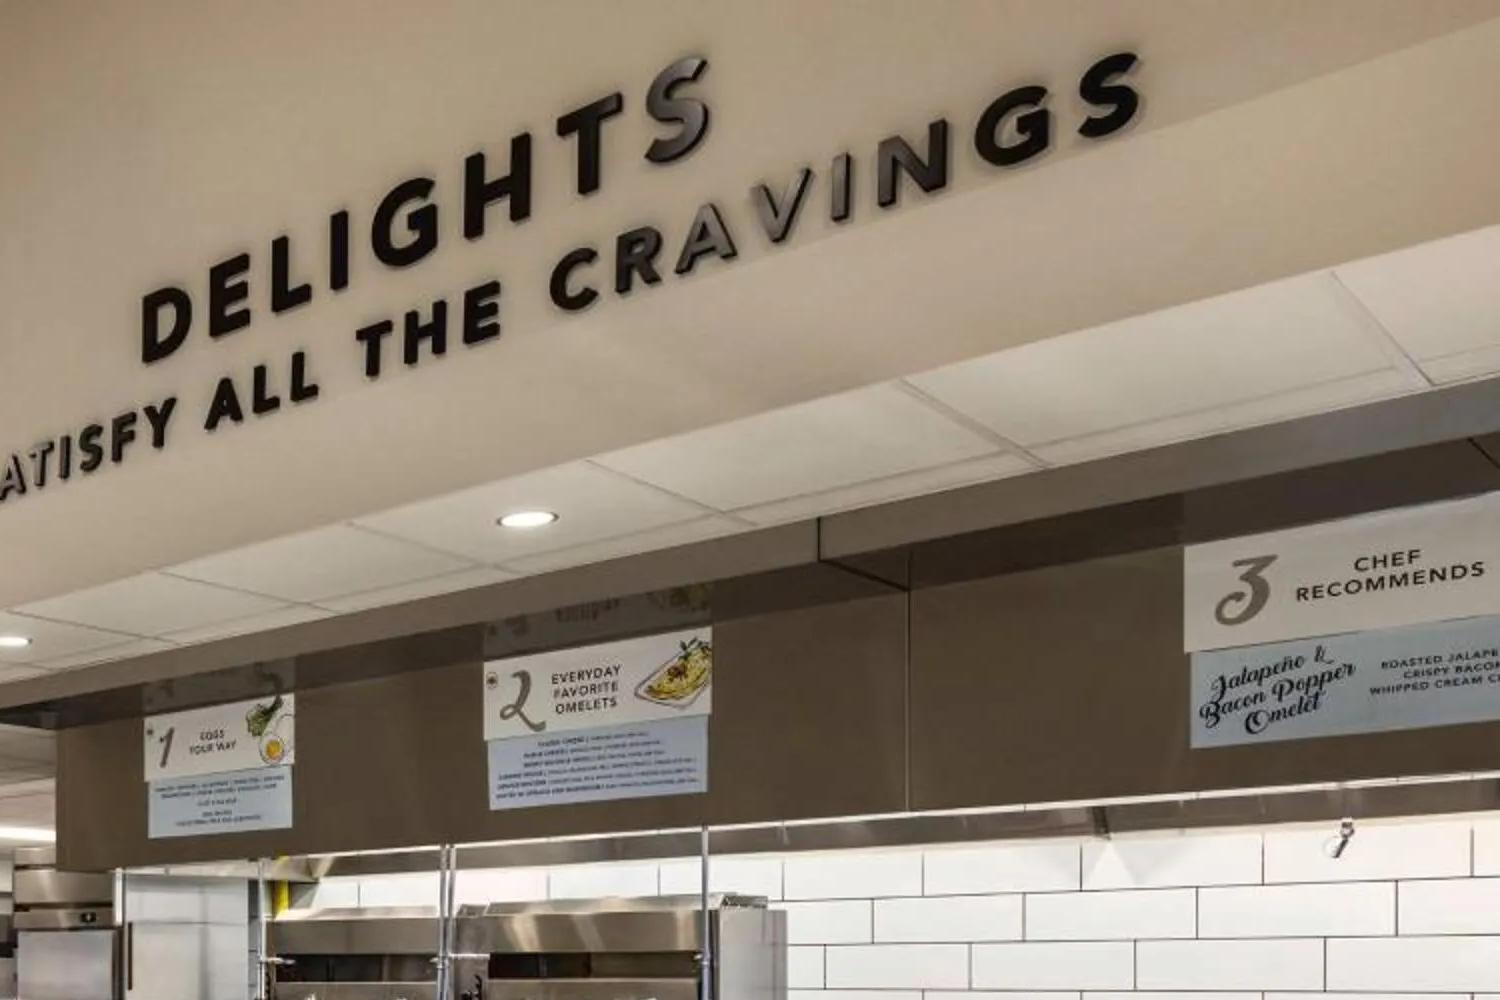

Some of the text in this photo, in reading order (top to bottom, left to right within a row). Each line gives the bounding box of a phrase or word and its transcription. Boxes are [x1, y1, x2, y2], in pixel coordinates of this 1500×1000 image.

[141, 55, 710, 363] DELIGHTS
[204, 351, 319, 431] ALL
[356, 280, 501, 379] THE
[549, 52, 1140, 311] CRAVINGS
[1296, 561, 1485, 602] RECOMMENDS
[1353, 549, 1421, 573] CHEF
[1214, 554, 1278, 626] 3
[551, 664, 622, 686] EVERYDAY
[1211, 655, 1306, 700] Jalapeño
[1381, 655, 1443, 669] ROASTED
[1403, 666, 1449, 679] CRISPY
[499, 669, 547, 732] 2
[553, 681, 619, 699] FAVORITE
[1200, 663, 1356, 729] Bacon Popper
[1369, 681, 1429, 695] WHIPPED
[1434, 675, 1483, 688] CREAM
[555, 698, 618, 714] OMELETS
[1244, 690, 1326, 735] Omelet
[159, 727, 175, 768] 1
